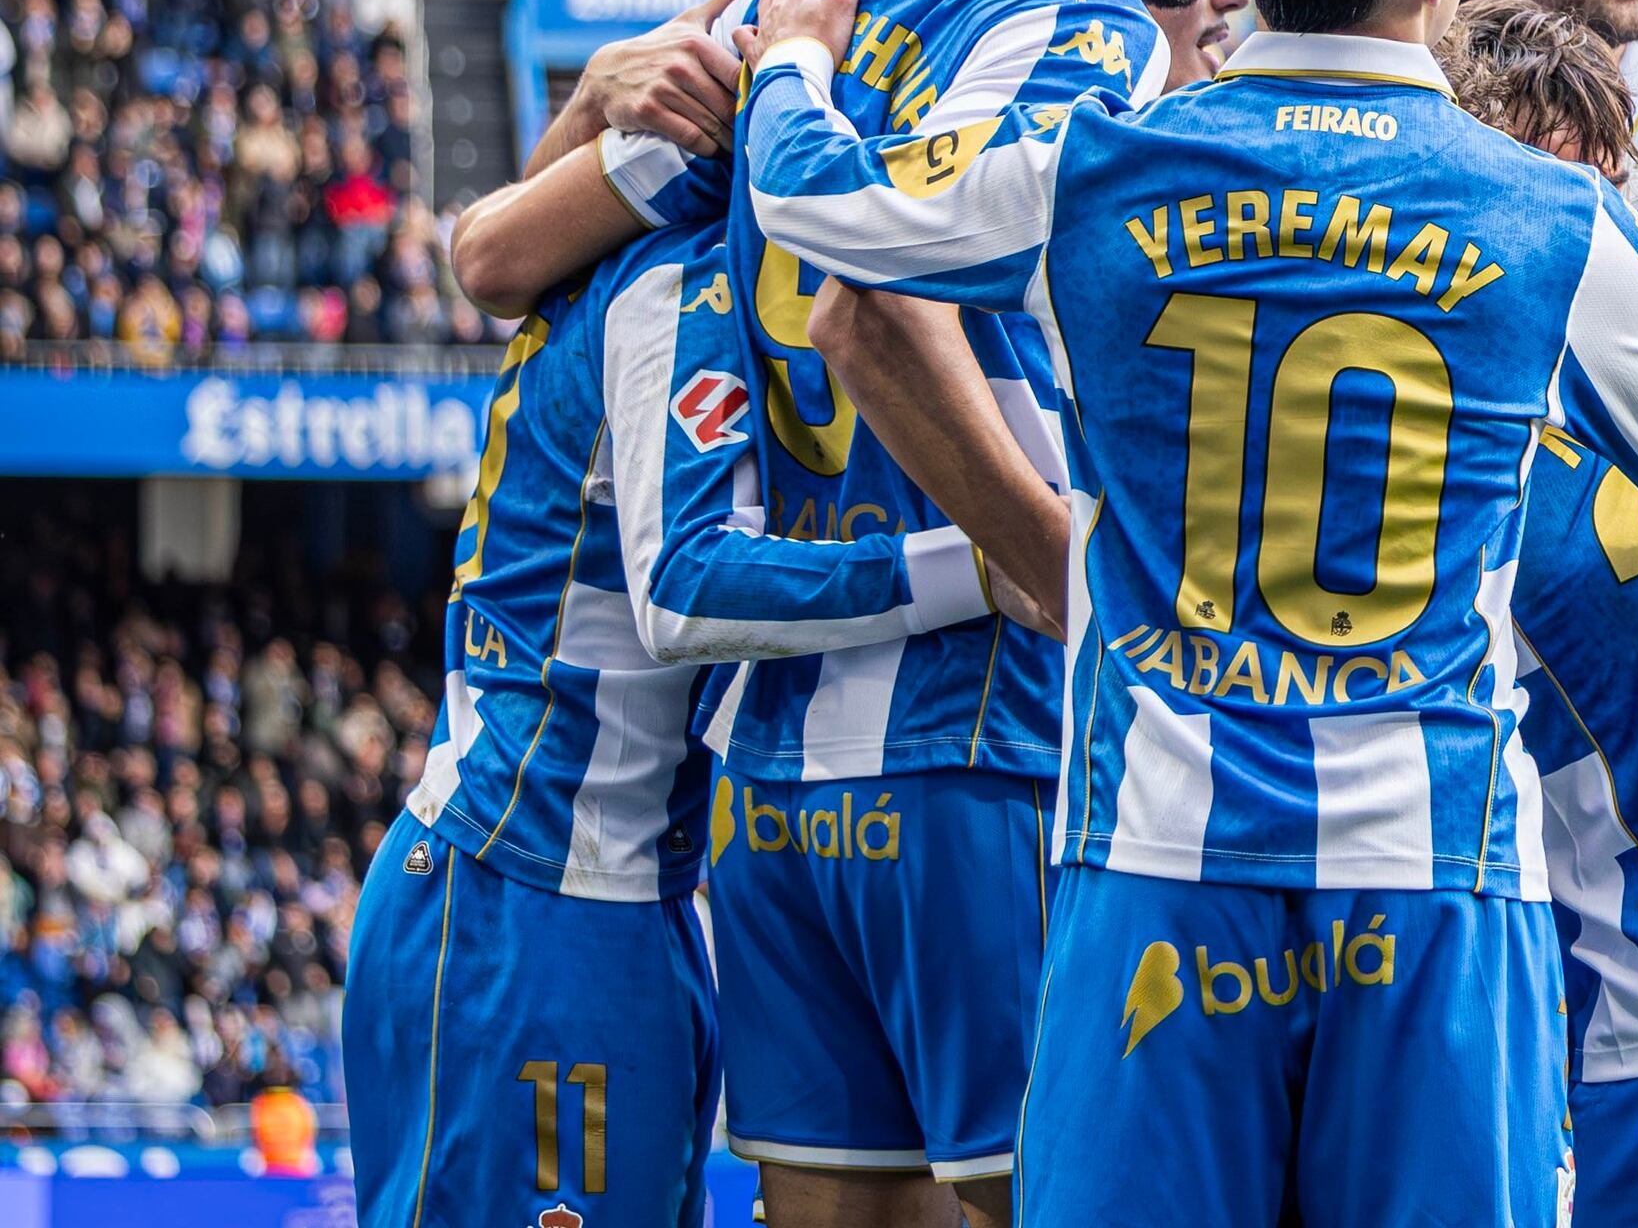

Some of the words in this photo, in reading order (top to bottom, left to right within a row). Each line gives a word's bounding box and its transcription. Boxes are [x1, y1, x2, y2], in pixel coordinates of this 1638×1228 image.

[1276, 105, 1398, 141] FEIRACO
[1125, 188, 1505, 314] YEREMAY
[181, 375, 477, 470] Estrella
[1145, 292, 1453, 647] 10
[743, 786, 901, 861] bualá
[1195, 913, 1397, 1017] bualá
[516, 1060, 608, 1194] 11
